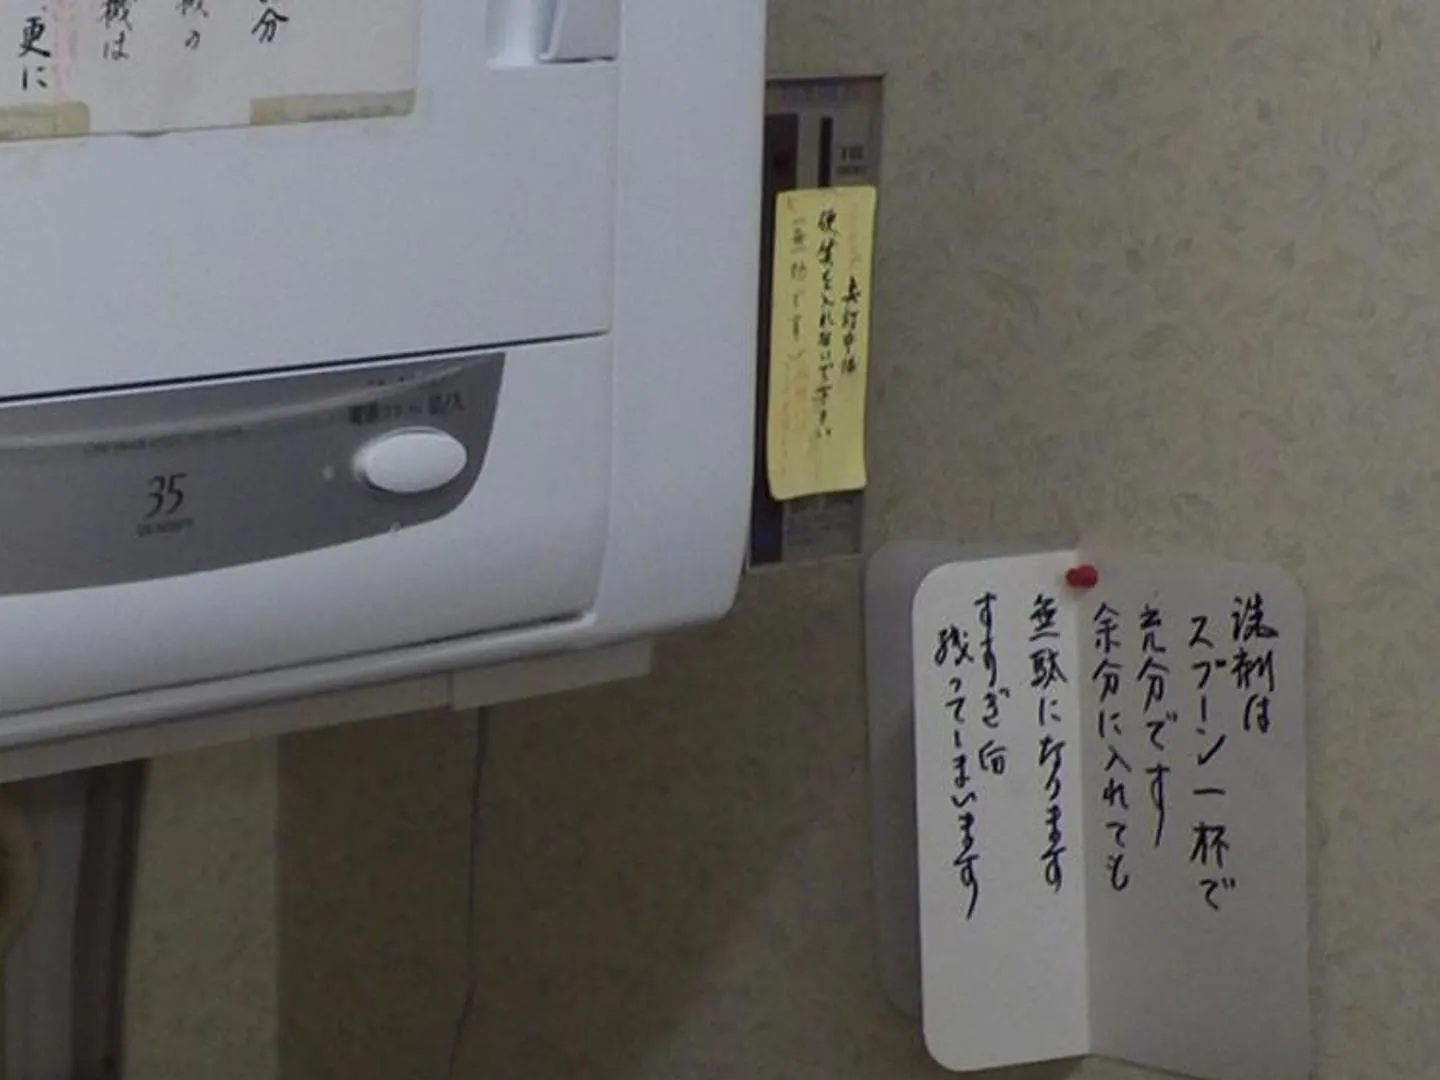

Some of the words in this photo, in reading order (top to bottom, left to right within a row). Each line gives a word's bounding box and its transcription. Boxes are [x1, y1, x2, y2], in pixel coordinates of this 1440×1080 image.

[144, 473, 187, 518] 35
[1231, 594, 1279, 732] 洗剤は
[1090, 601, 1132, 892] 余分に入れても
